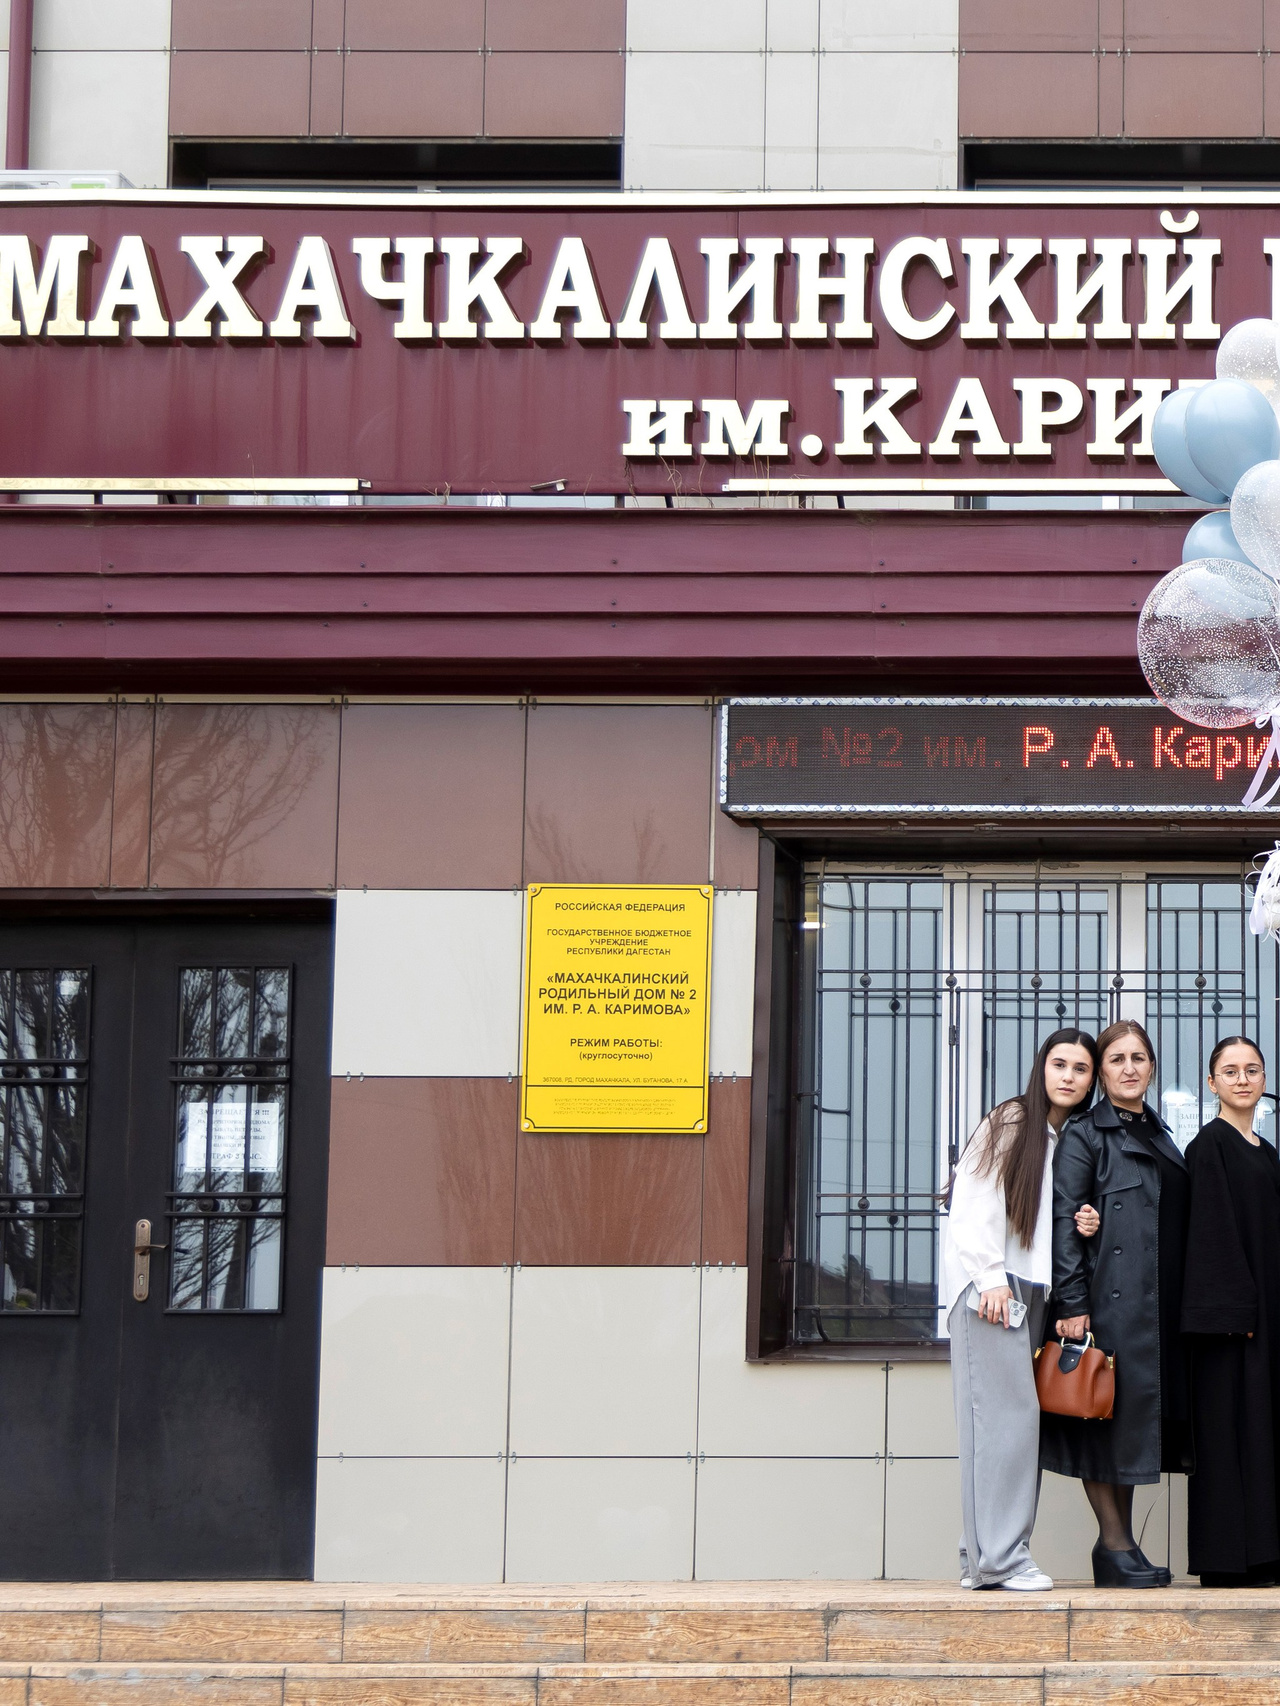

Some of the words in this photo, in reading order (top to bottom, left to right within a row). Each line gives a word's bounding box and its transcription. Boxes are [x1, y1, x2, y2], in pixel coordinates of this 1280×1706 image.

[0, 209, 1222, 342] МАХАЧКАЛИНСКИЙ
[730, 736, 798, 777] ом
[822, 727, 904, 767] №2
[924, 737, 1000, 767] им.
[1023, 726, 1070, 768] Р.
[1086, 726, 1134, 768] А.
[555, 901, 622, 911] РОССИЙСКАЯ
[625, 903, 686, 912] ФЕДЕРАЦИЯ
[547, 928, 632, 937] ГОСУДАРСТВЕННОЕ
[590, 938, 648, 946] УЧРЕЖДЕНИЕ
[566, 947, 623, 955] РЕСПУБЛИКИ
[626, 948, 671, 956] ДАГЕСТАН
[547, 971, 689, 984] «МАХАЧКАЛИНСКИЙ
[539, 986, 630, 1000] РОДИЛЬНЫЙ
[634, 989, 666, 1001] ДОМ
[670, 989, 685, 1000] №
[689, 989, 697, 1000] 2
[543, 1003, 568, 1014] ИМ.
[572, 1003, 583, 1014] Р.
[587, 1004, 600, 1014] А.
[605, 1004, 691, 1015] КАРИМОВА»
[570, 1038, 610, 1047] РЕЖИМ
[613, 1038, 663, 1048] РАБОТЫ:
[579, 1051, 653, 1061] (круглосуточно)
